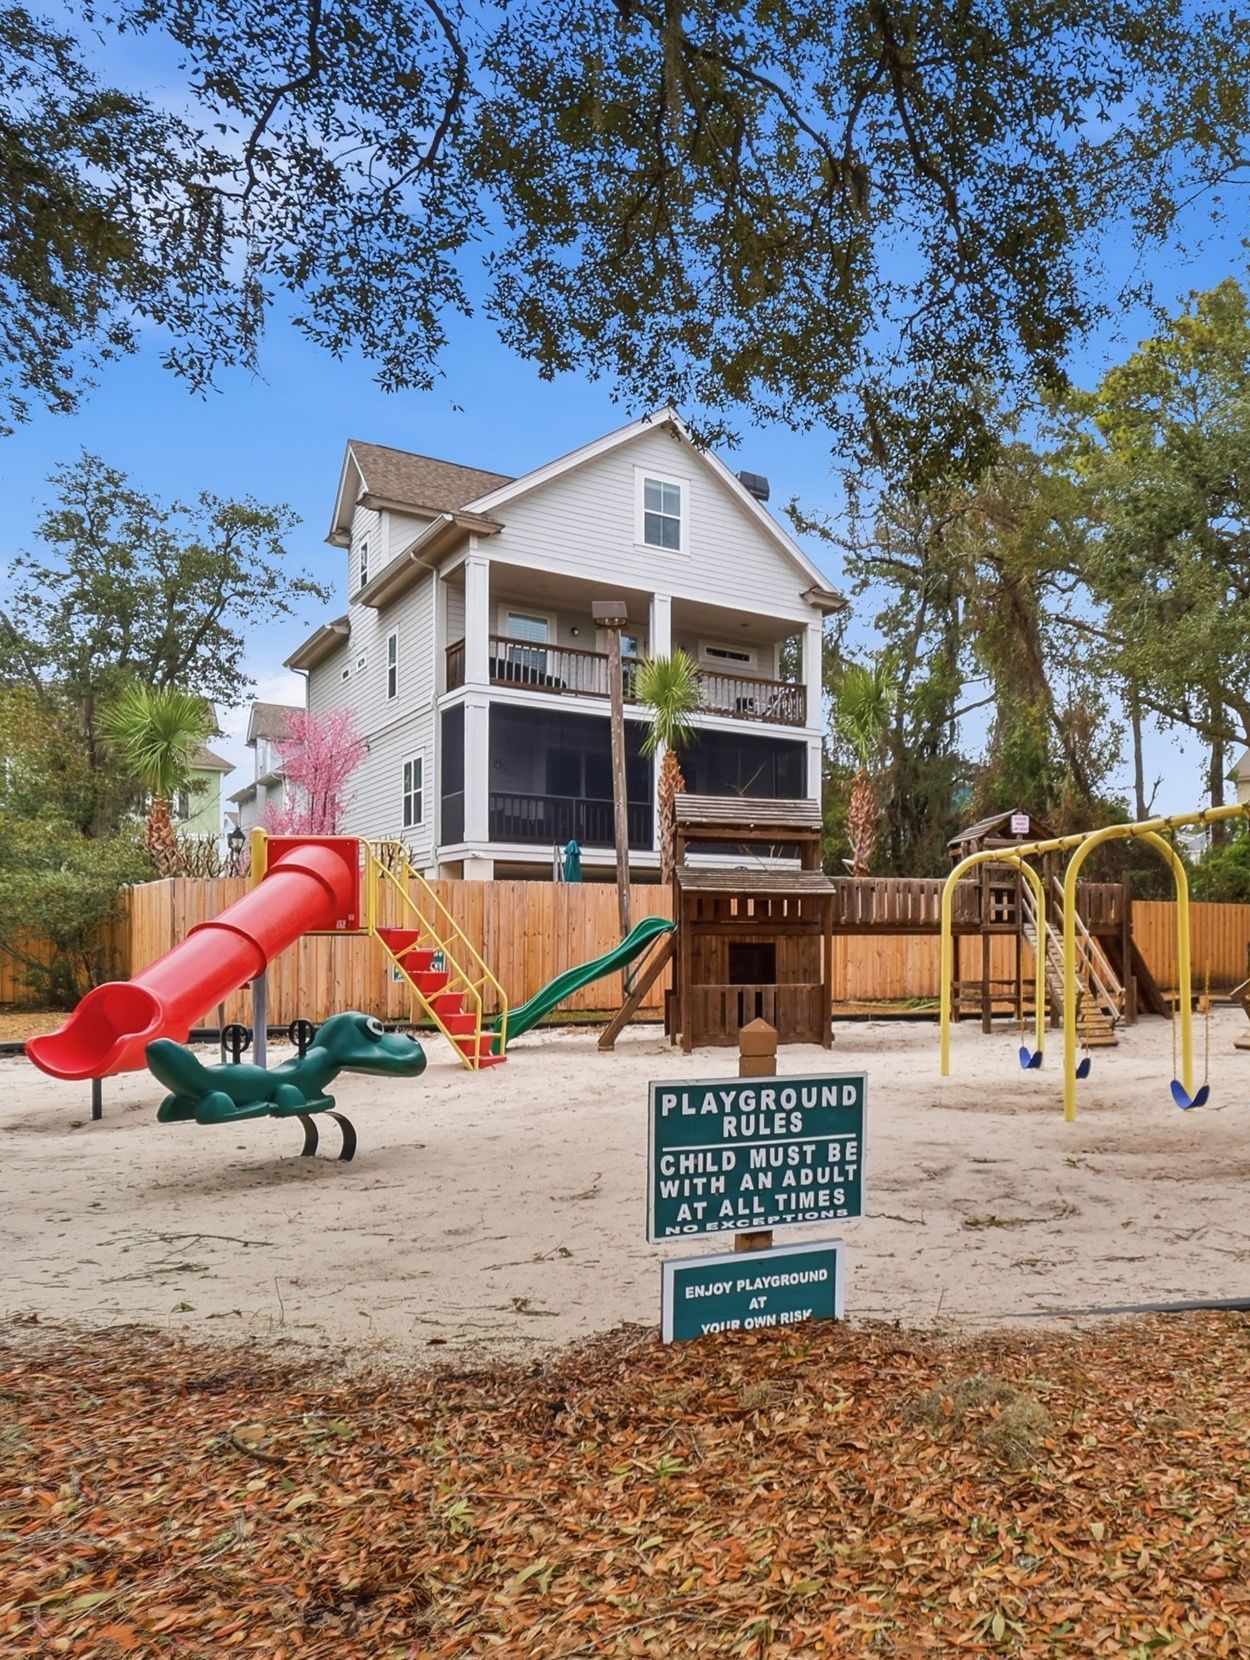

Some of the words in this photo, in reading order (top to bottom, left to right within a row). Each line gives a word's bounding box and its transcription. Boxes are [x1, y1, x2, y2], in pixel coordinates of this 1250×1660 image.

[662, 1085, 857, 1116] PLAYGROUND
[723, 1112, 803, 1137] RULES
[660, 1151, 736, 1176] CHILD
[750, 1145, 815, 1169] MUST
[828, 1142, 857, 1162] BE
[660, 1176, 725, 1198] WITH
[740, 1172, 772, 1191] AN
[782, 1165, 857, 1187] ADULT
[677, 1202, 707, 1221] AT
[719, 1196, 765, 1217] ALL
[775, 1189, 845, 1211] TIMES
[665, 1225, 698, 1235] NO
[706, 1209, 848, 1231] EXCEPTIONS
[685, 1281, 733, 1299] ENJOY
[736, 1269, 828, 1292] PLAYGROUND
[749, 1296, 767, 1310] AT
[744, 1314, 776, 1329] OWN
[780, 1308, 812, 1325] RISK
